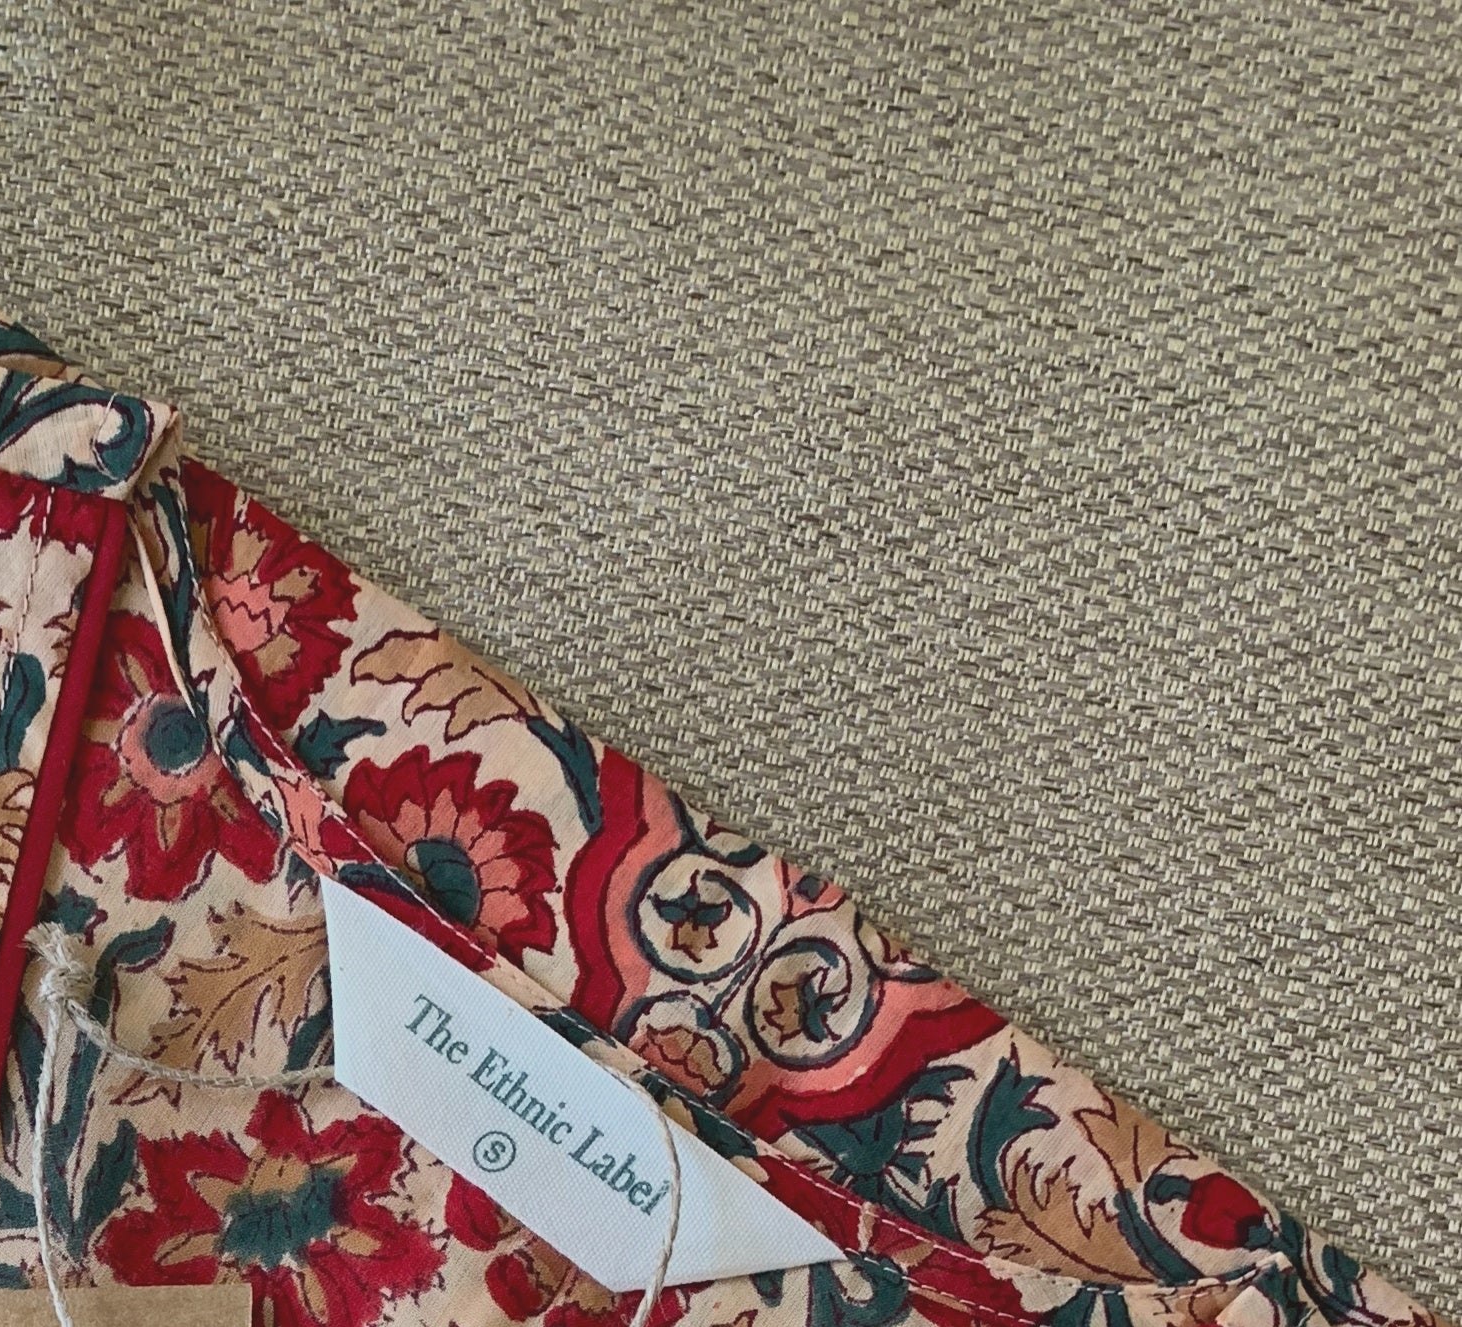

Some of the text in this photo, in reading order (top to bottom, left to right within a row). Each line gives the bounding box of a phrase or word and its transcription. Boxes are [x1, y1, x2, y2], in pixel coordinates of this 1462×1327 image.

[403, 993, 670, 1217] The Ethnic Label
